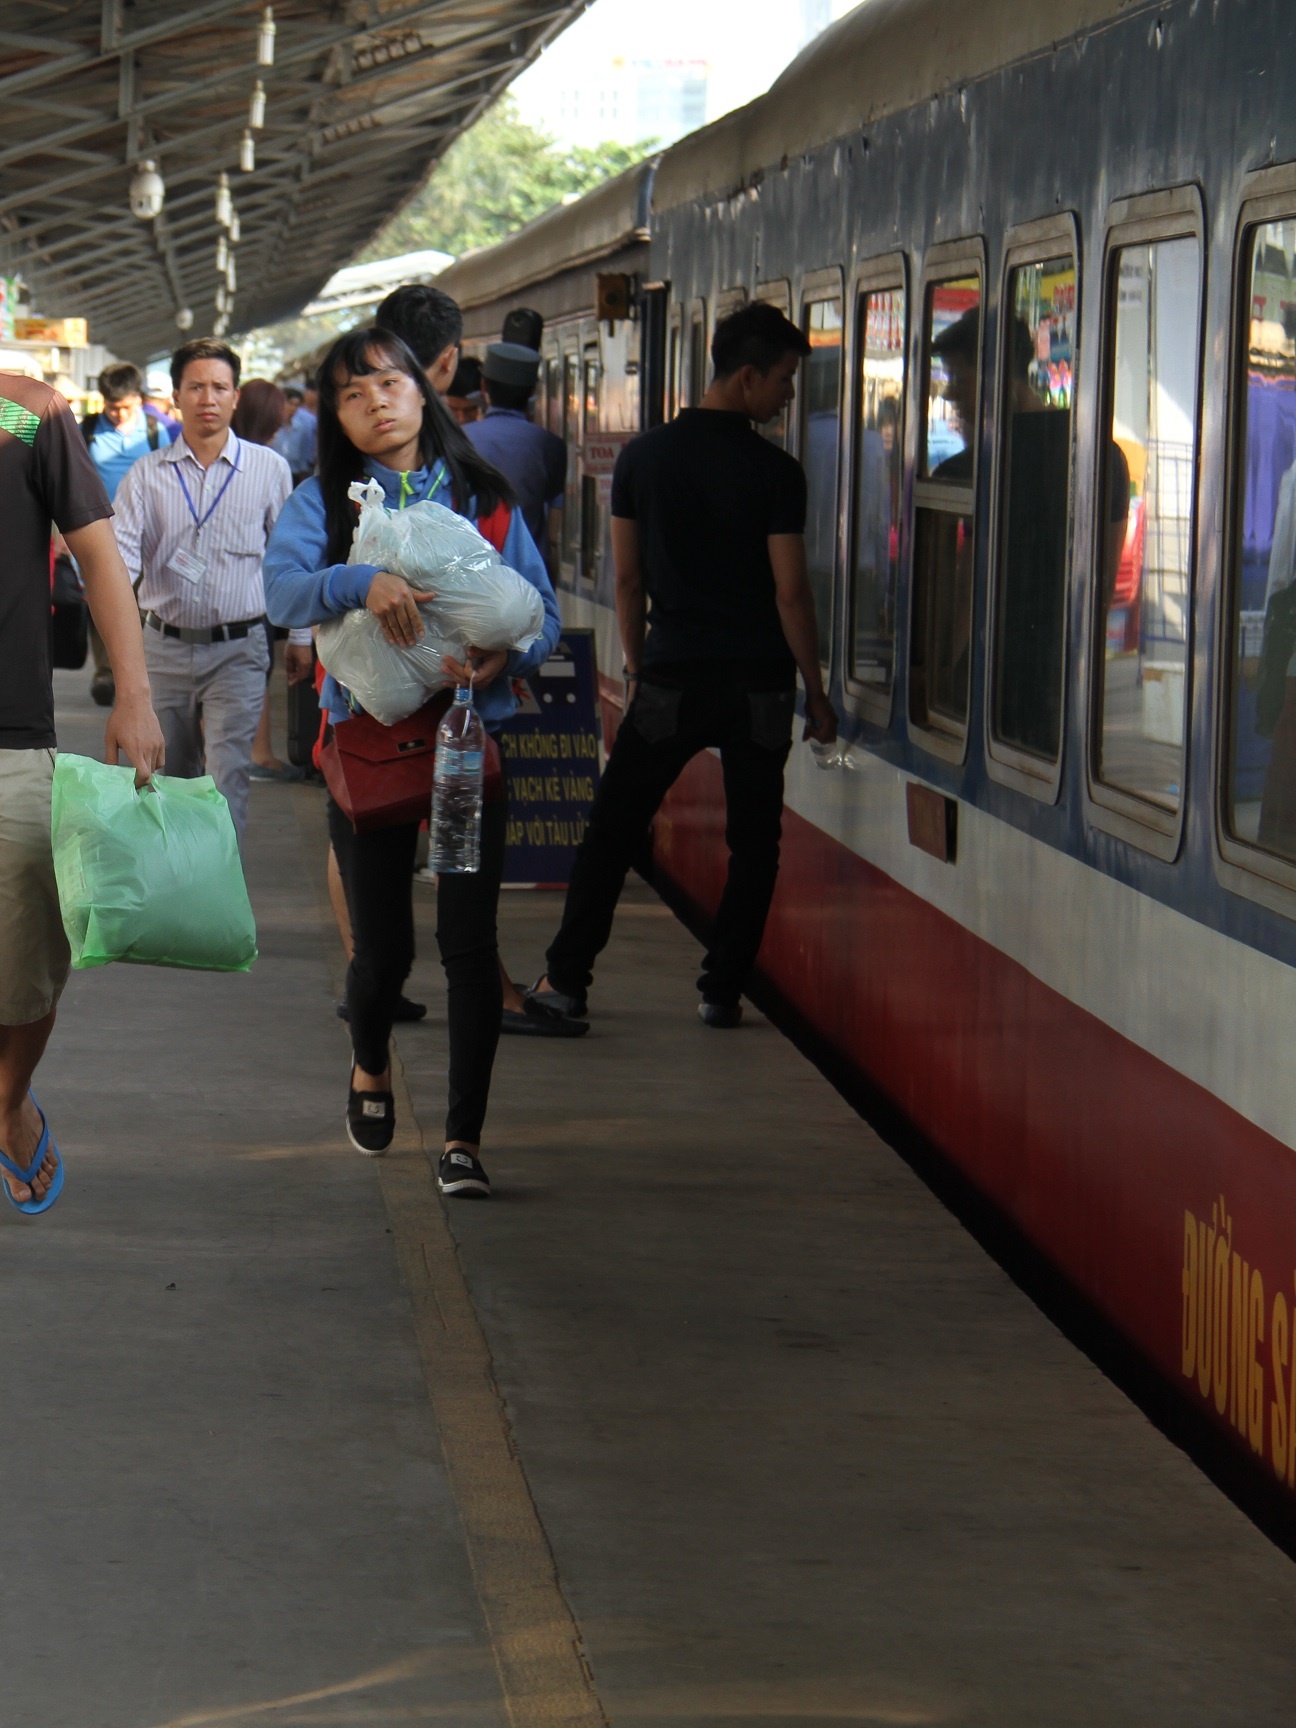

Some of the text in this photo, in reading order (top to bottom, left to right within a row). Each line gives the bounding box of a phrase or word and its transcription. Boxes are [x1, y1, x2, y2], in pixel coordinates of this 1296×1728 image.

[519, 727, 559, 759] KHÔNG
[560, 733, 572, 759] ĐI
[572, 727, 597, 759] VÀO
[512, 776, 544, 807] VẠCH
[562, 770, 595, 802] VÀNG
[546, 814, 569, 846] TÀU
[1182, 1193, 1265, 1458] ĐƯỜNG
